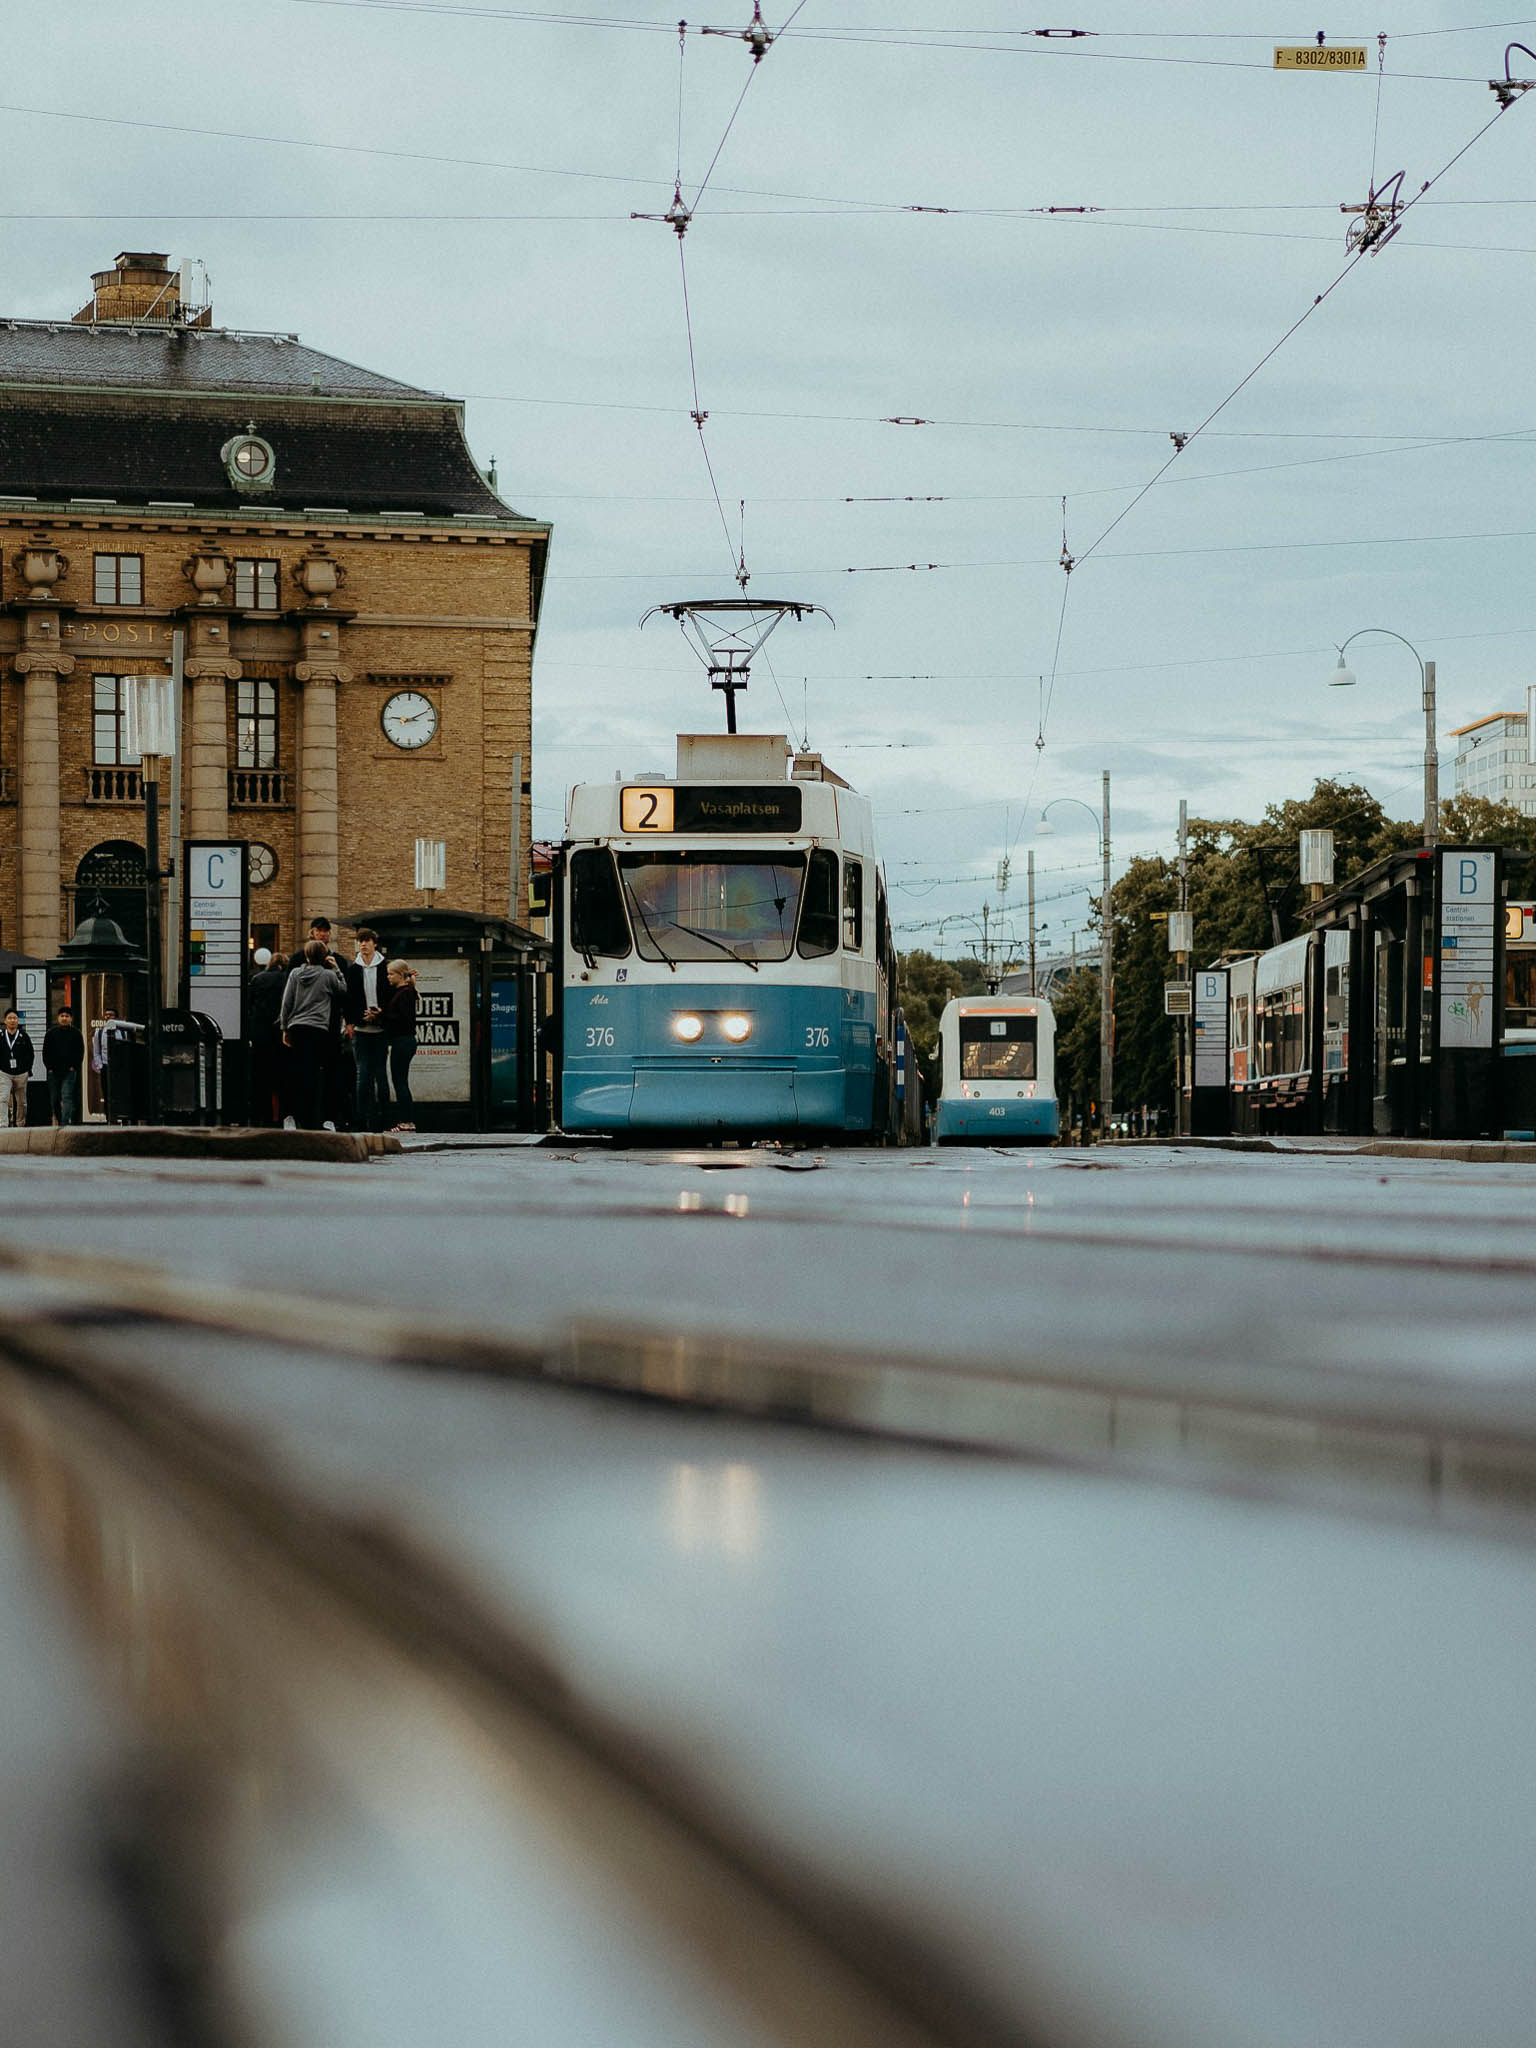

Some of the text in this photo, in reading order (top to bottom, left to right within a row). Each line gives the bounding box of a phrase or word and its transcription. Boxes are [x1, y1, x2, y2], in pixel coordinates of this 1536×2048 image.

[1276, 50, 1283, 65] F
[1295, 50, 1366, 65] 8302/8301A
[83, 623, 157, 643] POST
[638, 793, 781, 829] 2 Vasaplatsen
[208, 854, 224, 889] C
[1459, 859, 1478, 895] B
[25, 973, 37, 994] D
[1205, 976, 1217, 998] B
[585, 1026, 615, 1047] 376
[805, 1026, 829, 1047] 376
[988, 1106, 1006, 1117] 403
